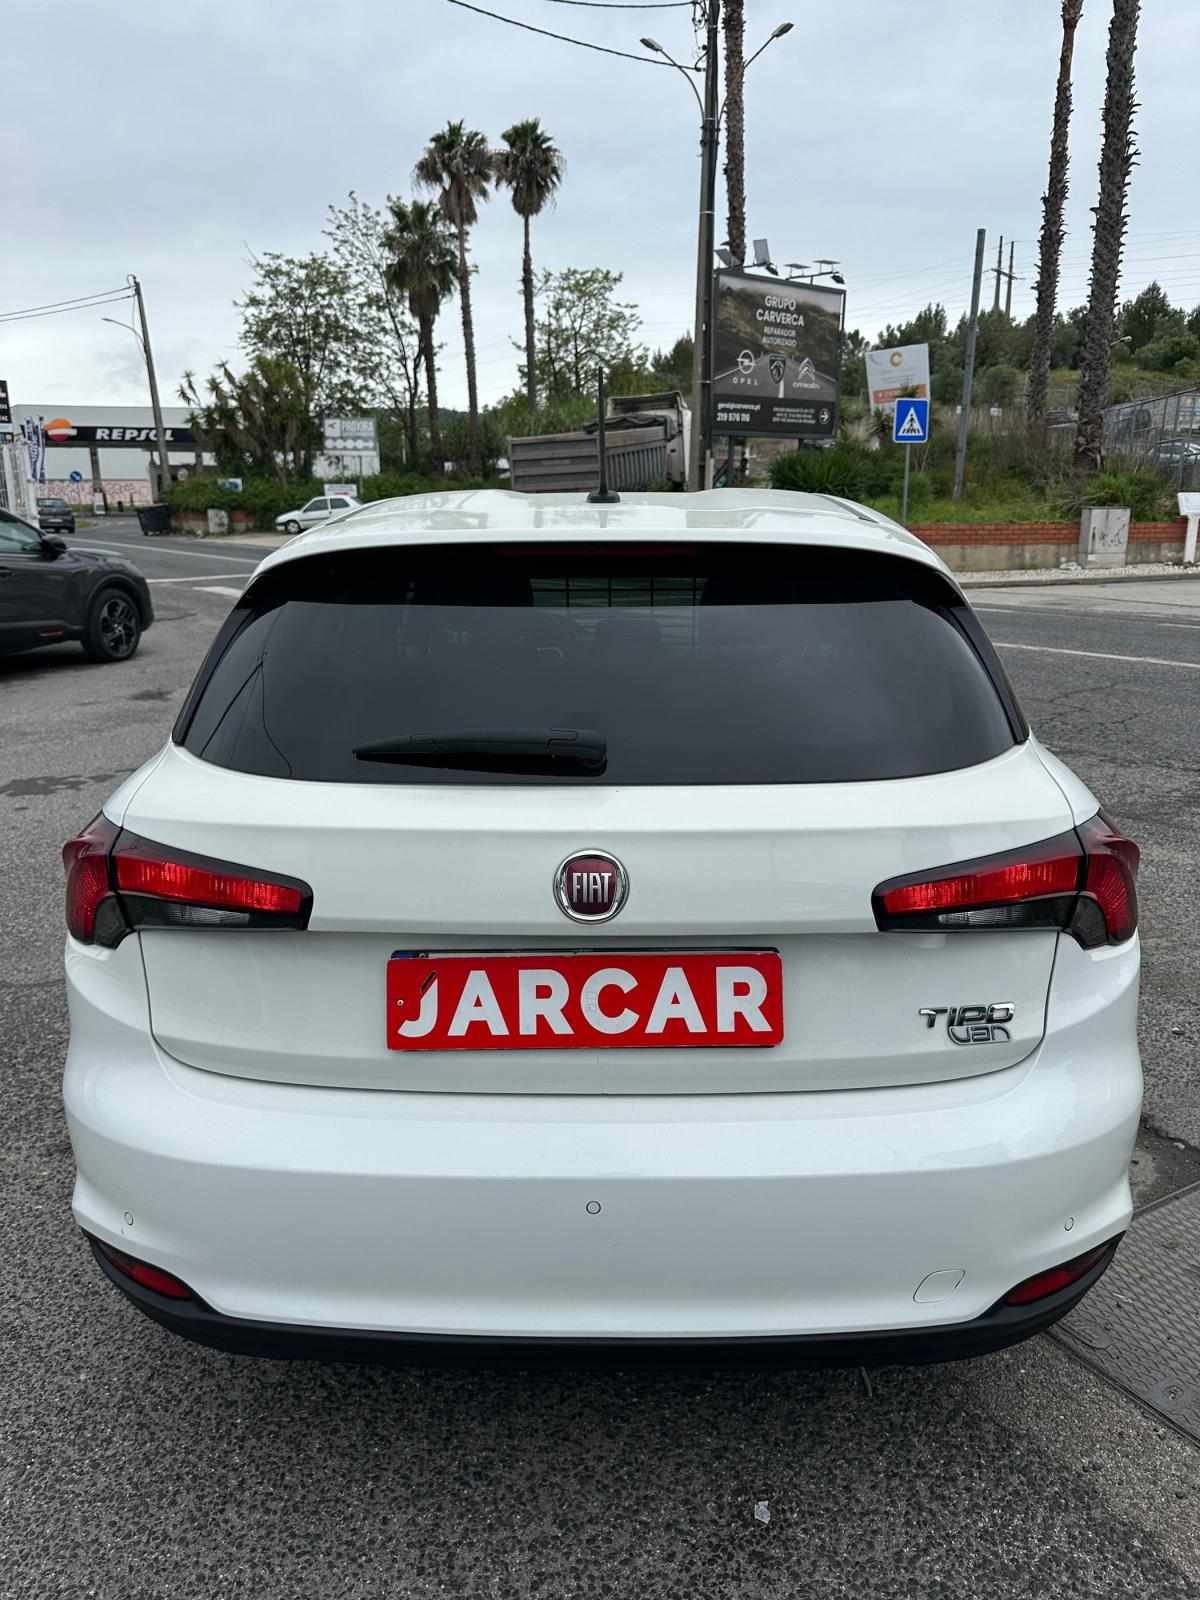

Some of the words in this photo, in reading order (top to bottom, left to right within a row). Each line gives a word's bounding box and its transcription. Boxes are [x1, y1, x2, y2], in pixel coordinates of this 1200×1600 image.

[765, 295, 797, 311] GRUPO
[756, 309, 804, 327] CARVERCA
[732, 377, 759, 387] OPEL
[572, 872, 612, 903] FIAT
[397, 967, 773, 1038] JARCAR
[919, 1001, 1016, 1028] TIPO
